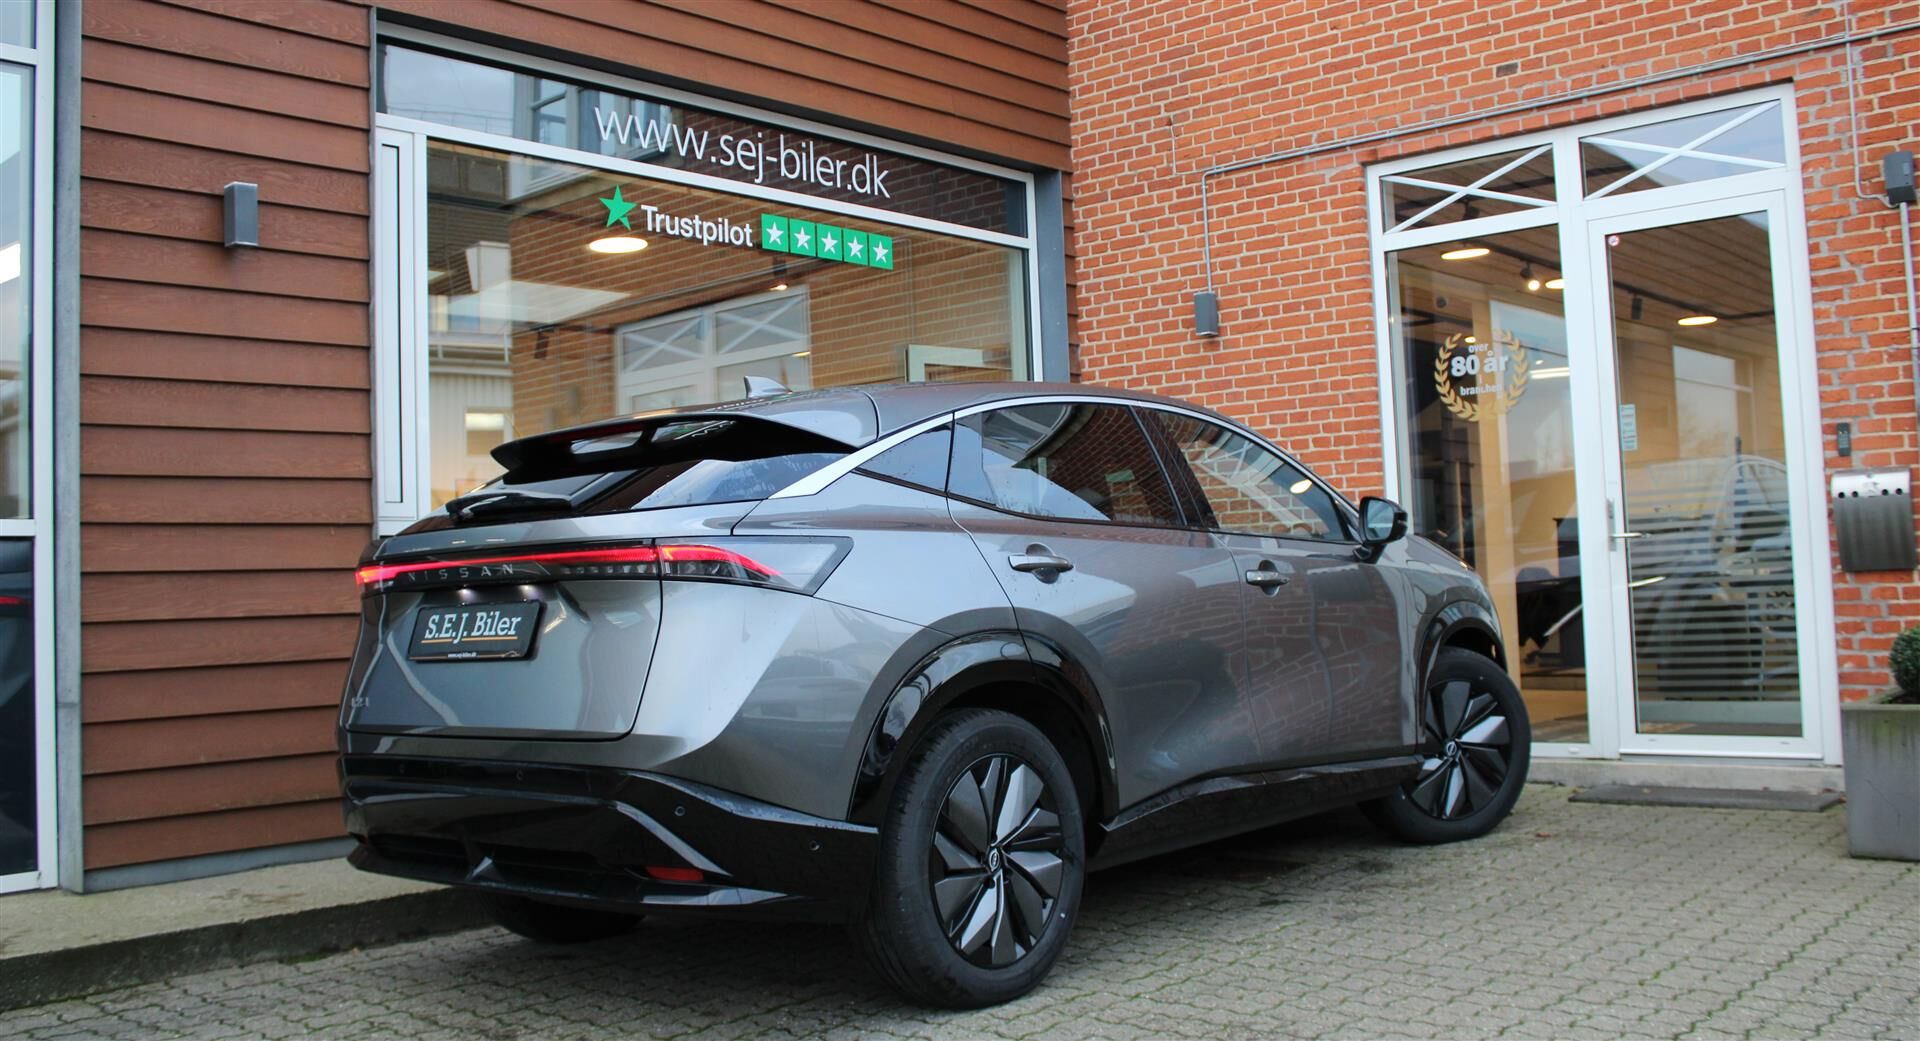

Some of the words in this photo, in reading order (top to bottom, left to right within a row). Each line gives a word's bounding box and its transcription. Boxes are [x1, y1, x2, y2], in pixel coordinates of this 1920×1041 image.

[594, 106, 891, 198] www.sej-biler.dk
[640, 204, 754, 247] Trustpilot
[1468, 343, 1489, 353] over
[1451, 354, 1480, 377] 80
[1483, 350, 1509, 373] år
[408, 563, 514, 582] NISSAN
[424, 614, 468, 644] S.E.J.
[471, 611, 522, 637] Biler
